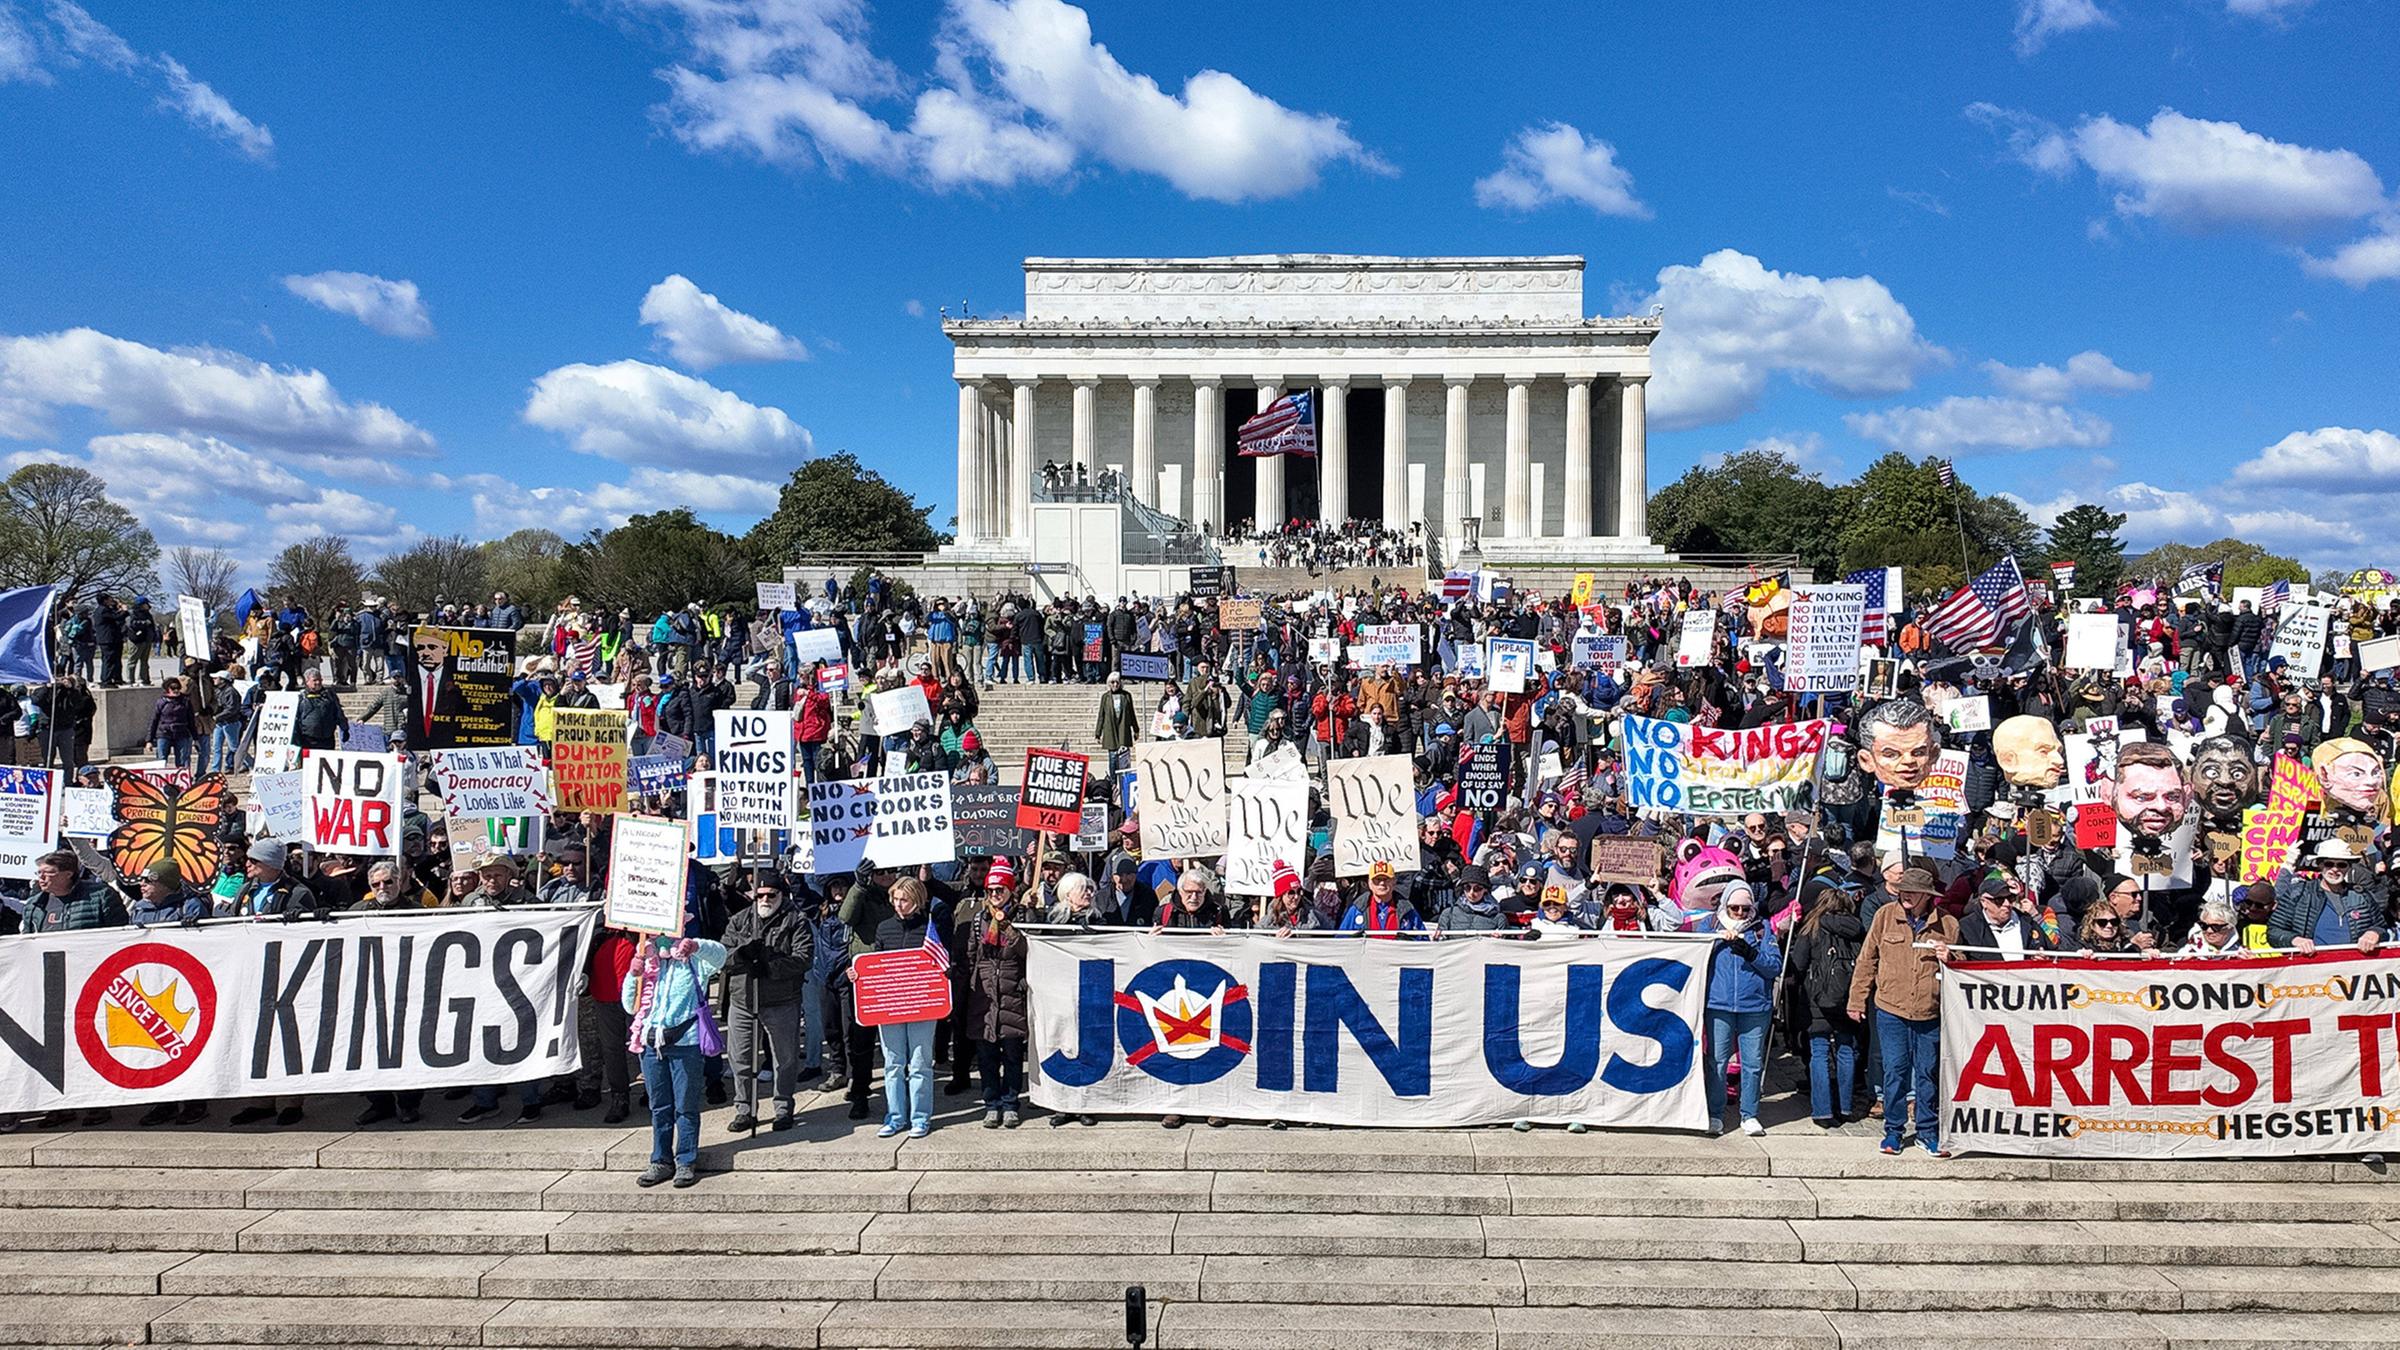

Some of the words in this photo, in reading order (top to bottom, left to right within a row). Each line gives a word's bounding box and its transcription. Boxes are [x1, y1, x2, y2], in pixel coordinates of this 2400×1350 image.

[1193, 586, 1220, 595] VOTE!
[1816, 592, 1834, 602] NO
[1836, 592, 1862, 601] KING
[1793, 606, 1810, 614] NO
[1812, 605, 1860, 614] DICTATOR
[1792, 614, 1810, 624] NO
[1813, 614, 1860, 624] TYRANT
[1792, 625, 1808, 634] NO
[1811, 624, 1858, 634] FASCIST
[2283, 626, 2318, 638] DON'T
[450, 631, 484, 658] No
[1576, 636, 1625, 644] DEMOCRACY
[1791, 634, 1808, 644] NO
[1811, 634, 1858, 644] RACIST
[2276, 637, 2303, 646] BOW
[2306, 640, 2321, 650] TO
[1494, 642, 1530, 654] IMPEACH
[1588, 644, 1614, 652] NEEDS
[1588, 652, 1614, 660] YOUR
[1122, 658, 1168, 675] EPSTEIN?
[1788, 676, 1806, 690] NO
[1808, 674, 1856, 690] TRUMP
[462, 690, 510, 700] EXECUTIVE
[262, 722, 289, 732] DON'T
[556, 713, 586, 726] MAKE
[731, 716, 767, 738] NO
[278, 736, 289, 746] TO
[472, 736, 512, 744] ENGLISH
[556, 729, 592, 742] PROUD
[594, 730, 626, 744] AGAIN
[1623, 714, 1681, 749] NO
[1692, 720, 1826, 760] KINGS
[554, 744, 614, 761] DUMP
[1474, 754, 1496, 762] ENDS
[1482, 745, 1498, 754] ALL
[448, 753, 475, 772] This
[478, 752, 490, 770] Is
[492, 750, 524, 770] What
[718, 750, 787, 774] KINGS
[1030, 756, 1064, 774] ¡QUE
[1065, 760, 1084, 776] SE
[1472, 763, 1498, 772] WHEN
[1629, 749, 1680, 780] NO
[317, 756, 384, 798] NO
[556, 762, 623, 781] TRAITOR
[639, 764, 682, 779] RESIST!
[1465, 772, 1502, 780] ENOUGH
[448, 774, 532, 792] Democracy
[721, 780, 736, 794] NO
[738, 780, 788, 798] TRUMP
[811, 783, 844, 802] NO
[878, 773, 945, 794] KINGS
[1028, 772, 1081, 793] LARGUE
[1143, 757, 1214, 804] We
[1488, 782, 1504, 790] SAY
[462, 792, 500, 811] Looks
[504, 792, 526, 810] Like
[559, 782, 622, 808] TRUMP
[1028, 788, 1077, 808] TRUMP
[1334, 773, 1406, 820] We
[1464, 790, 1499, 808] NO
[1632, 778, 1682, 809] NO
[722, 795, 738, 809] NO
[741, 796, 783, 812] PUTIN
[813, 804, 844, 824] NO
[850, 794, 944, 820] CROOKS
[1936, 798, 1956, 807] and
[126, 810, 160, 819] PROTECT
[178, 812, 211, 822] CHILDREN
[312, 795, 391, 849] WAR
[720, 810, 732, 823] NO
[733, 812, 787, 828] KHAMENEI
[954, 808, 1008, 821] LOADING
[1039, 810, 1064, 826] YA!
[1171, 803, 1200, 828] the
[1236, 794, 1300, 844] We
[1892, 806, 1917, 823] LICKER
[2252, 811, 2299, 826] end
[815, 827, 846, 846] NO
[876, 814, 948, 838] LIARS
[1362, 818, 1392, 842] the
[2036, 816, 2046, 840] ADOLF
[2096, 832, 2110, 840] NO
[954, 828, 1022, 849] BOLISH
[1148, 821, 1221, 855] People
[2212, 842, 2231, 851] TOOL
[2344, 834, 2368, 845] SHAM
[964, 846, 985, 855] ICE
[1257, 842, 1284, 865] the
[1342, 837, 1414, 870] People
[2244, 846, 2288, 864] CR
[2138, 862, 2164, 872] POSER
[1959, 982, 2081, 1011] TRUMP
[2147, 982, 2268, 1010] BONDI
[0, 943, 218, 1094] NO
[250, 925, 581, 1080] KINGS!
[108, 976, 155, 1024] SINCE
[148, 1017, 186, 1060] 1776
[1041, 957, 1434, 1098] JOIN
[1483, 956, 1696, 1097] US
[1952, 1018, 2312, 1108] ARREST
[2337, 1012, 2400, 1098] T
[1950, 1108, 2072, 1138] MILLER
[2216, 1106, 2383, 1140] HEGSETH
